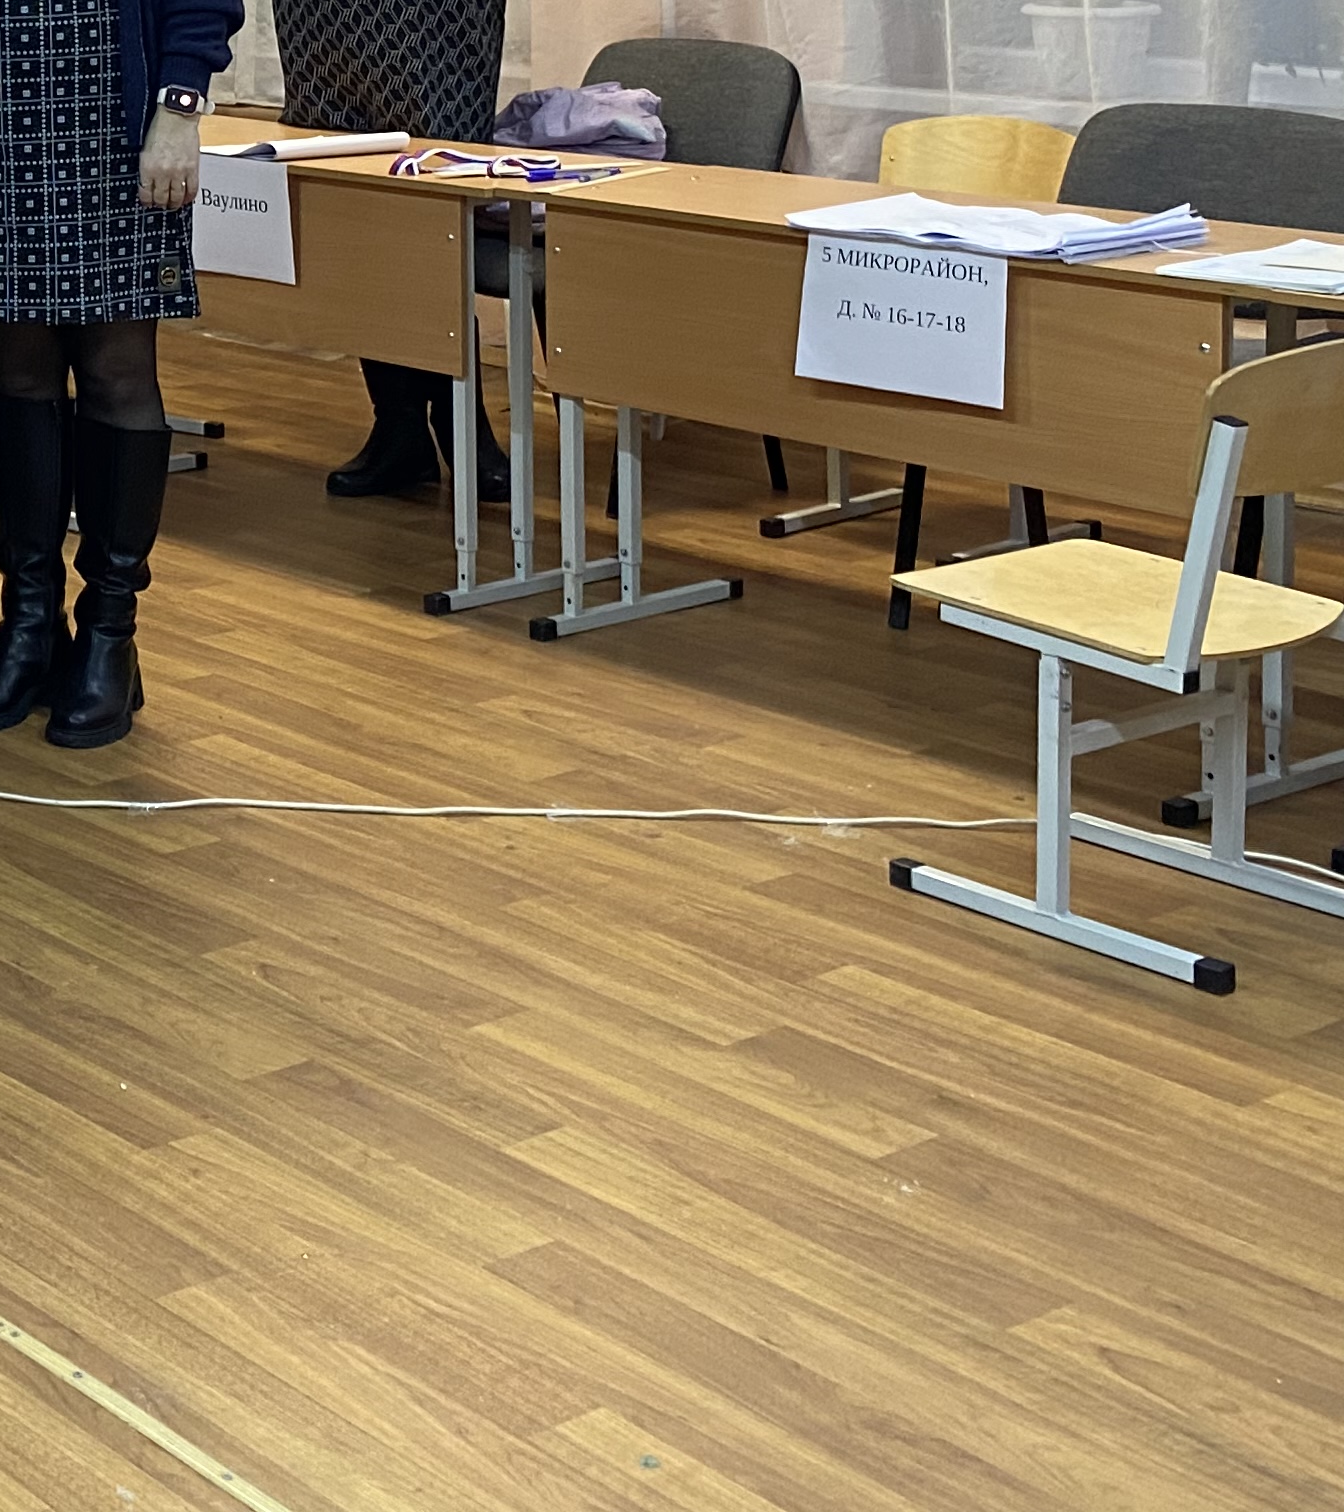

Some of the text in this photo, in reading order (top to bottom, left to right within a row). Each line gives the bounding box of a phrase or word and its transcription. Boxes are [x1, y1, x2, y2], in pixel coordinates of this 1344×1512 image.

[201, 188, 268, 213] Ваулино
[822, 247, 989, 286] 5 МИКРОРАЙОН,
[837, 300, 966, 333] Д. № 16-17-18
